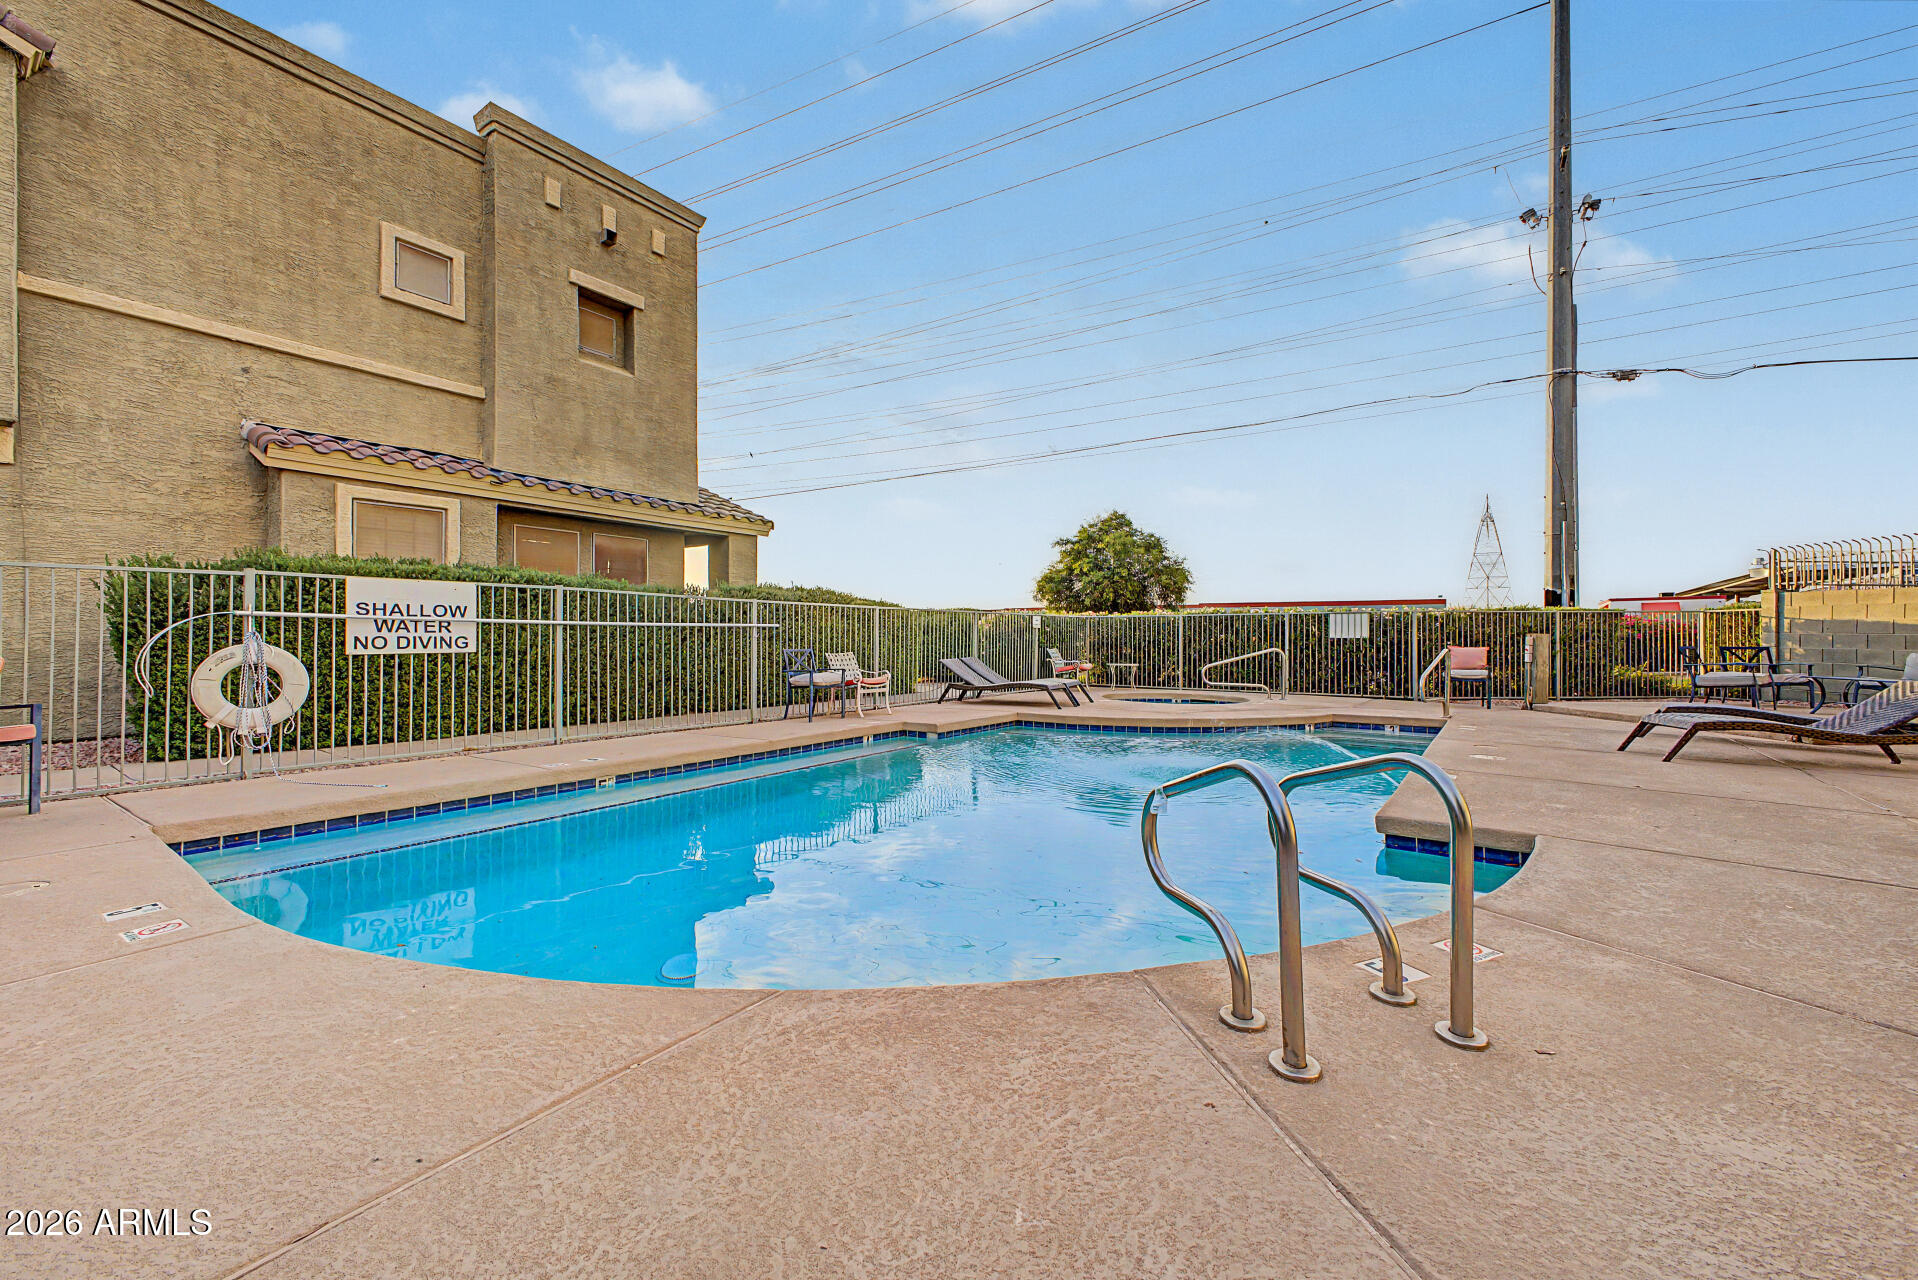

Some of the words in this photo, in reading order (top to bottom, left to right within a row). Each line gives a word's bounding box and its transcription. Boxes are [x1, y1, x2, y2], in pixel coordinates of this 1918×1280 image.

[356, 602, 467, 618] SHALLOW
[374, 619, 452, 633] WATER
[353, 636, 388, 650] NO
[396, 636, 469, 650] DIVING
